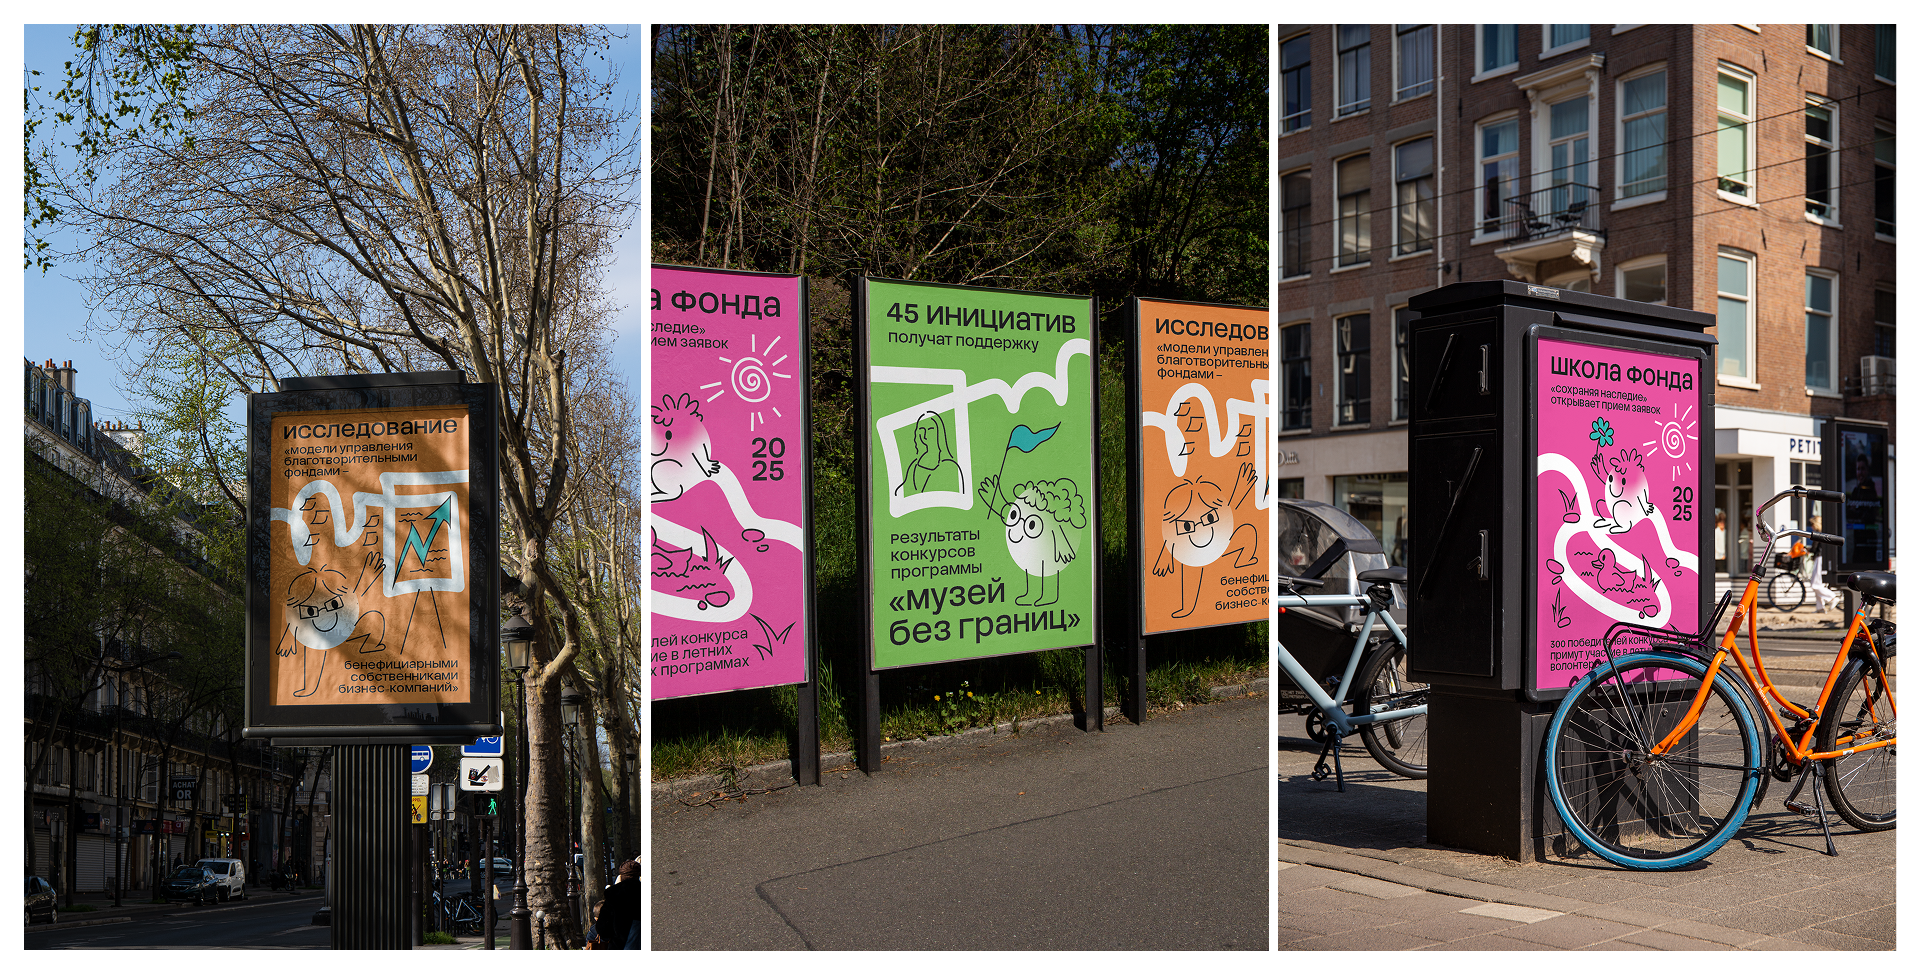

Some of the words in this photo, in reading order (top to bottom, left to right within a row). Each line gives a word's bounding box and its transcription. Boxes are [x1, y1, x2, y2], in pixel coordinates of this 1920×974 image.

[886, 302, 919, 324] 45
[680, 338, 729, 349] заявок
[888, 331, 953, 347] получат
[956, 336, 1039, 353] поддержку
[1157, 343, 1211, 354] «модели
[1157, 367, 1214, 380] фондами
[1551, 385, 1599, 397] «сохраняя
[1600, 389, 1647, 403] наследие»
[1551, 396, 1600, 409] открывает
[1601, 401, 1630, 411] прием
[1631, 404, 1661, 415] заявок
[283, 419, 458, 440] исследование
[284, 445, 337, 456] «модели
[339, 442, 413, 455] управления
[752, 437, 785, 458] 20
[284, 453, 418, 466] благотворительными
[284, 467, 340, 479] фондами
[752, 460, 784, 481] 25
[1673, 486, 1693, 503] 20
[1673, 504, 1692, 521] 25
[891, 547, 976, 562] конкурсов
[891, 563, 982, 581] программы
[889, 576, 1005, 615] «музей
[1226, 586, 1269, 598] собств
[1215, 597, 1269, 611] бизнес-к
[889, 618, 951, 646] без
[959, 609, 1081, 644] границ»
[681, 629, 748, 645] конкурса
[1550, 640, 1566, 648] 300
[671, 650, 679, 660] в
[682, 644, 733, 660] летних
[1551, 650, 1584, 661] примут
[1585, 647, 1621, 659] учасие
[344, 659, 458, 671] бенефициарными
[661, 656, 750, 677] программах
[350, 672, 458, 682] собственниками
[338, 682, 459, 694] бизнес-компаний»
[172, 781, 195, 789] ACHAT
[176, 789, 192, 800] OR
